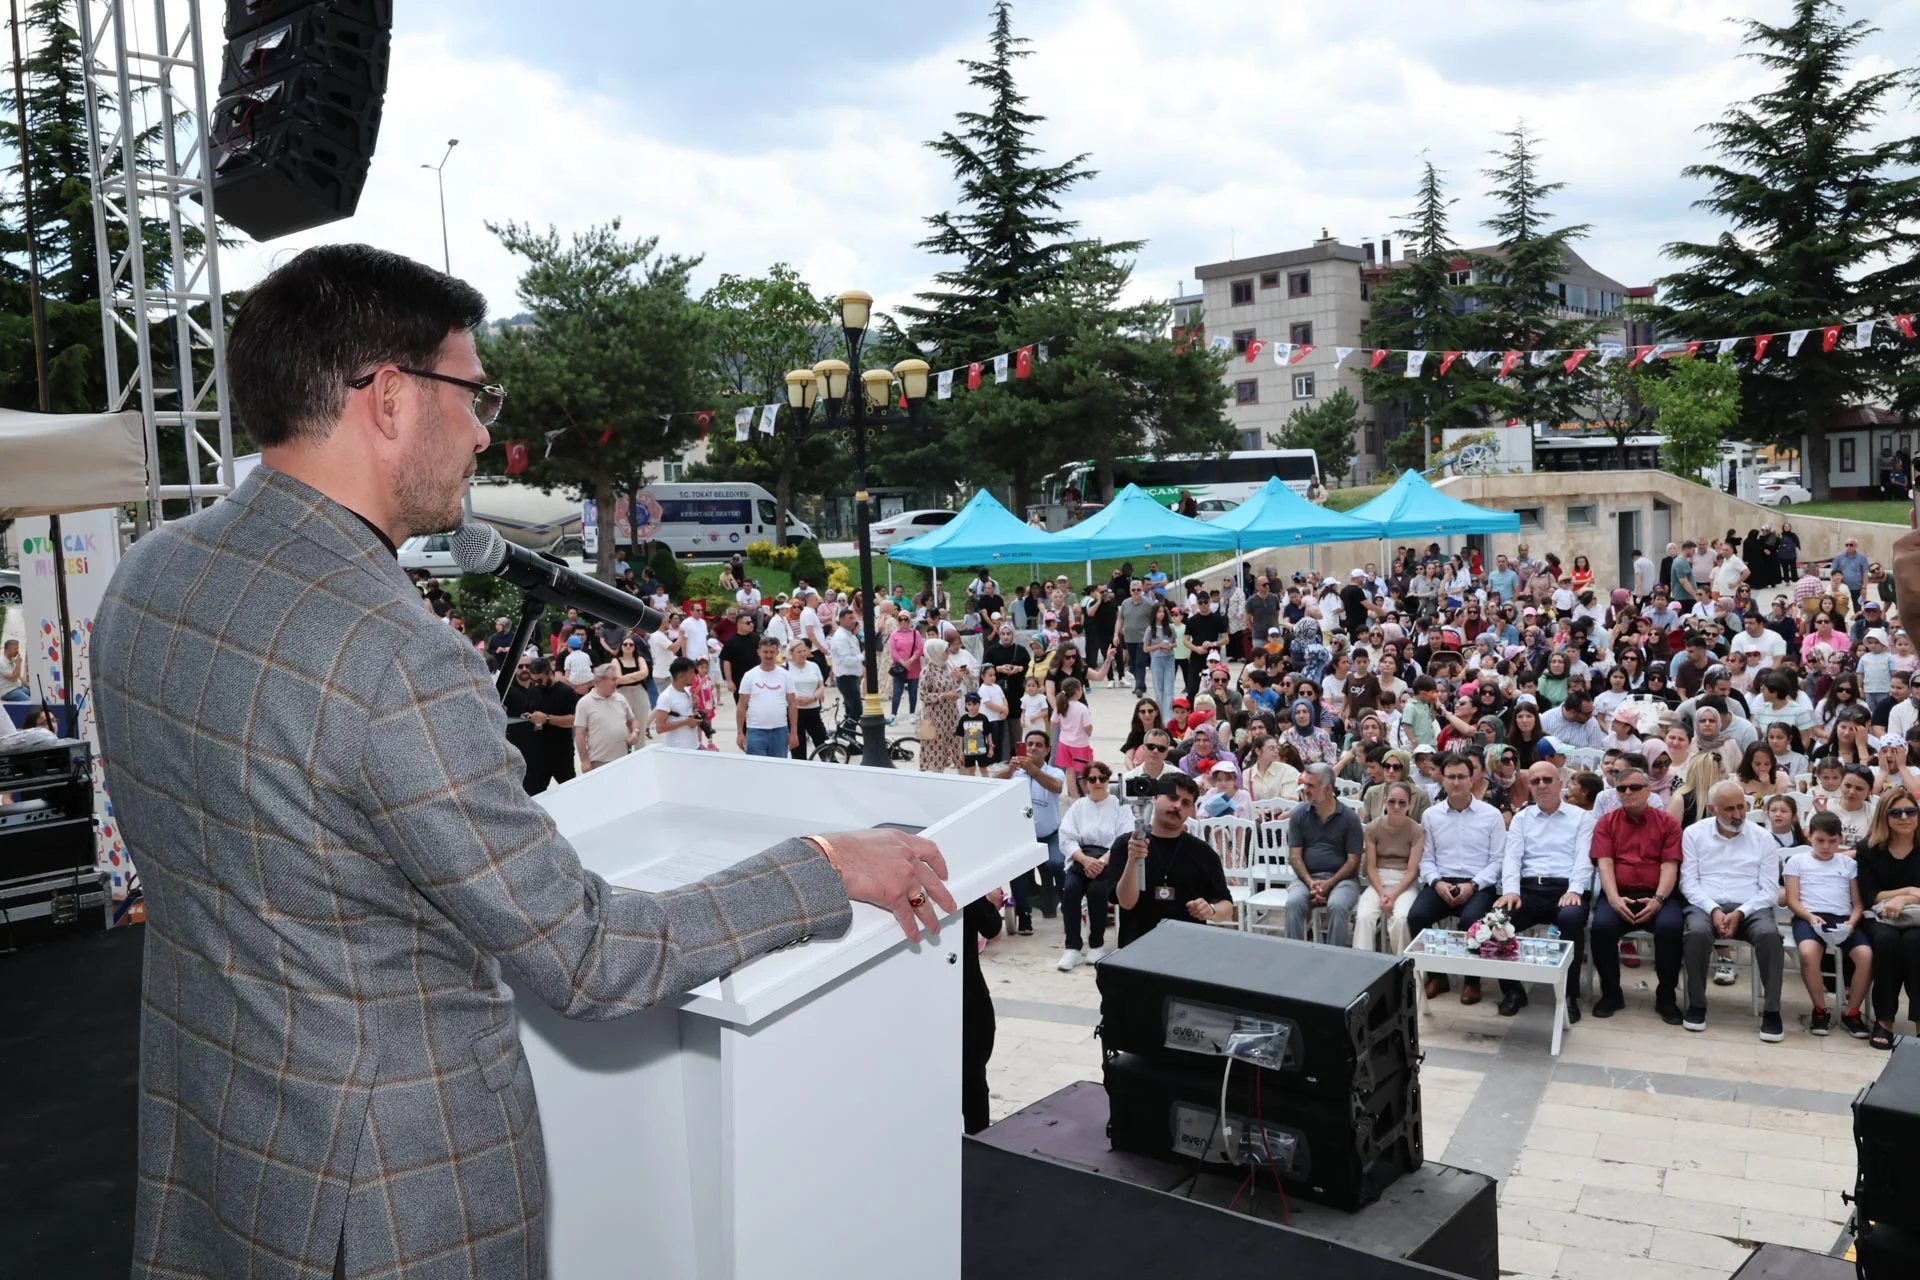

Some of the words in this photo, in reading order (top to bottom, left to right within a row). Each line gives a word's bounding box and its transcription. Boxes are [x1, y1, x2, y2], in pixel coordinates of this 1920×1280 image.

[714, 490, 750, 498] BELEDİYESİ
[23, 534, 97, 555] OYUCAK
[35, 556, 89, 576] MESİ
[1172, 1026, 1206, 1039] event
